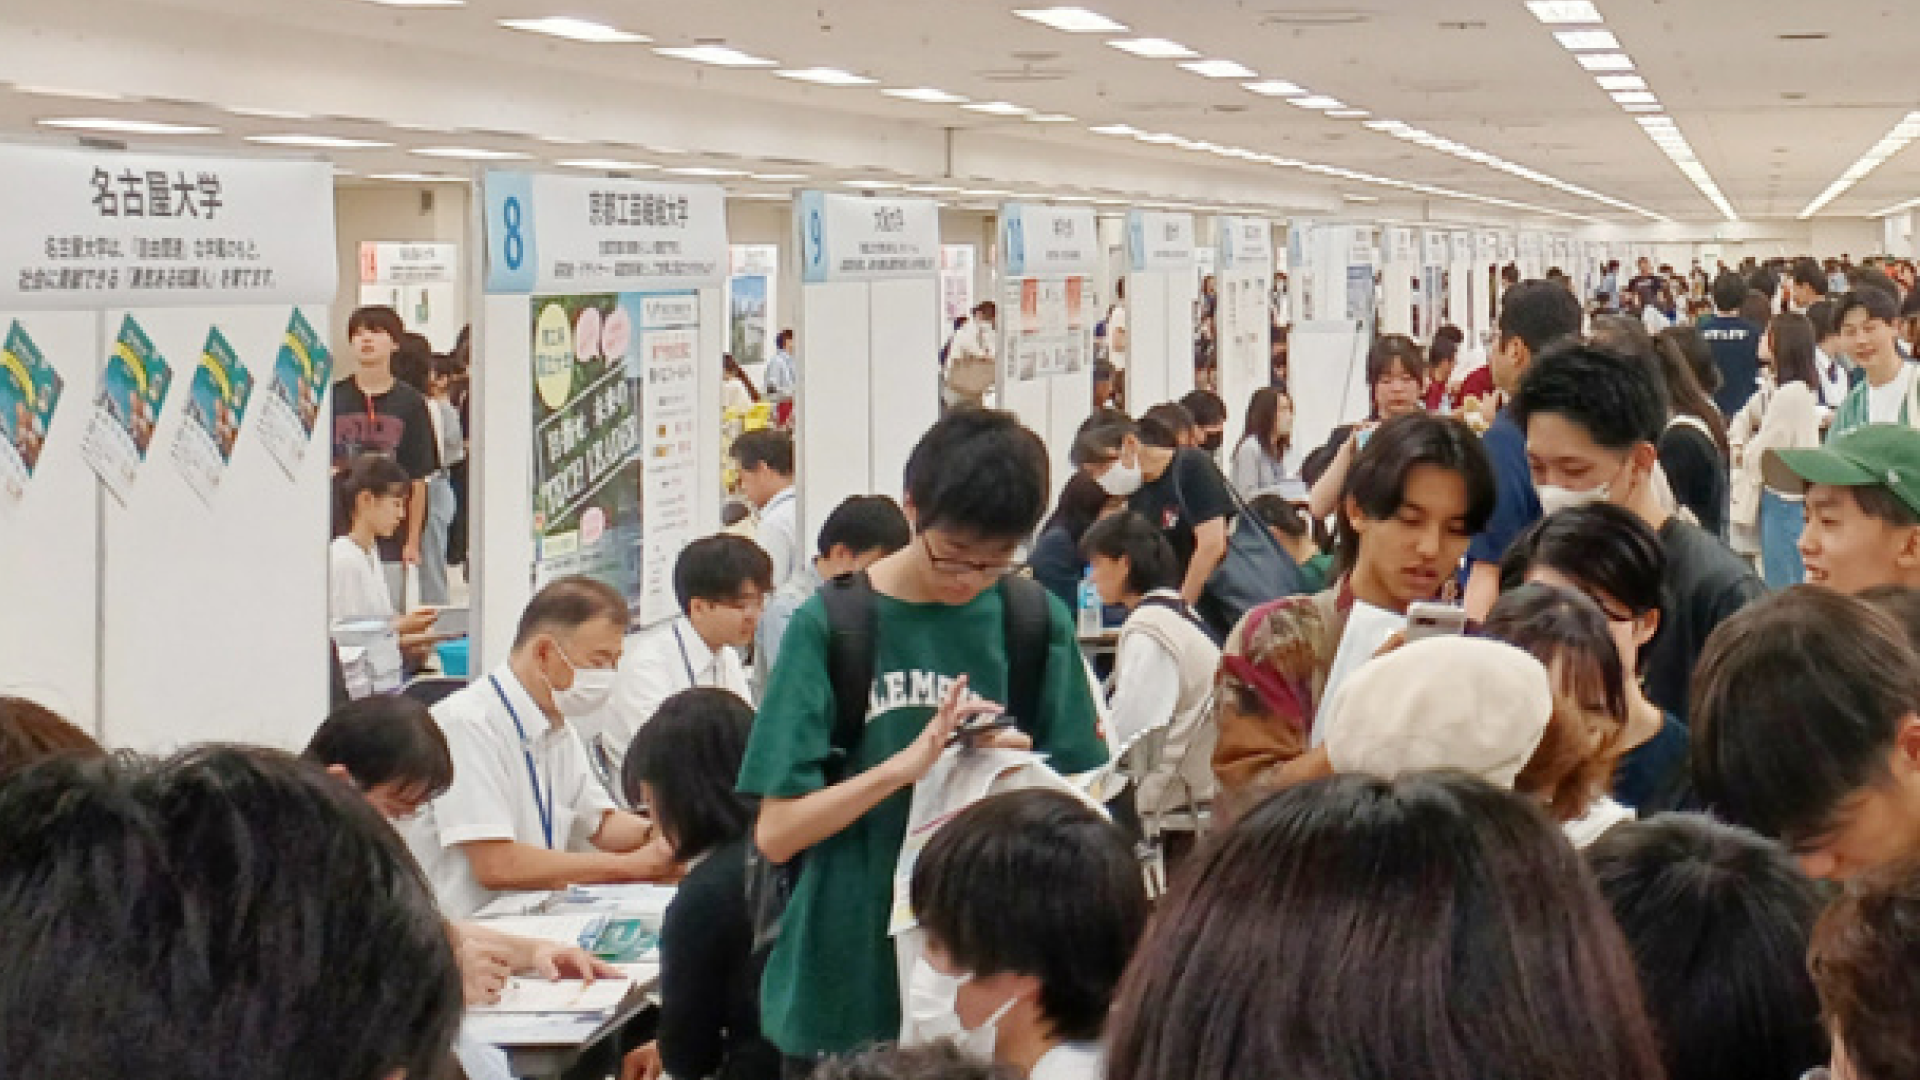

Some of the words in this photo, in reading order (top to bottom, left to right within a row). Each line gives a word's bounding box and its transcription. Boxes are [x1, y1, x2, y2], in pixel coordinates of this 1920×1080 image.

[89, 165, 223, 219] 名古屋大学
[503, 196, 524, 271] 8
[810, 208, 822, 267] 9
[1703, 329, 1749, 340] STAFF
